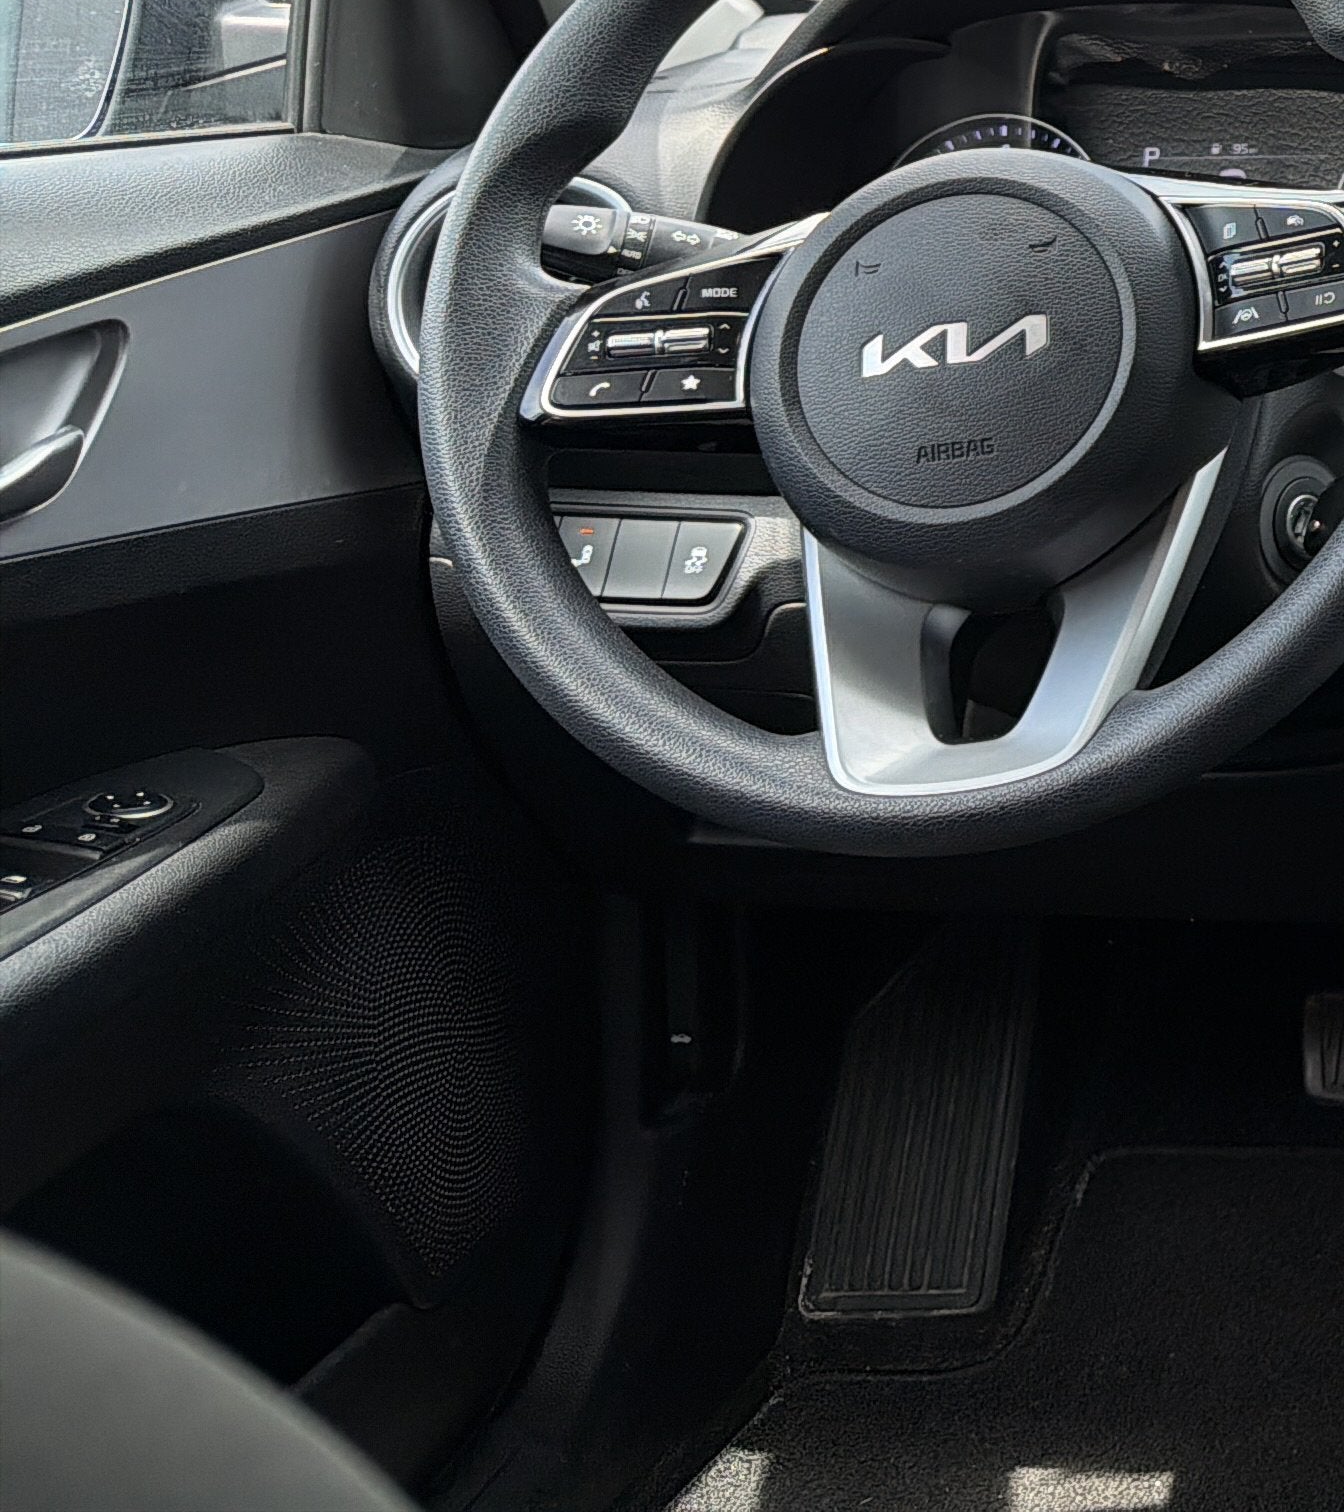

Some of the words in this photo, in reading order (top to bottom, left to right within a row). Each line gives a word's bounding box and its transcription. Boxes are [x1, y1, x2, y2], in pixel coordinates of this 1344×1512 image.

[1143, 146, 1160, 168] P
[701, 287, 739, 298] MODE
[861, 314, 1048, 378] KIA
[915, 438, 996, 465] AIRBAG
